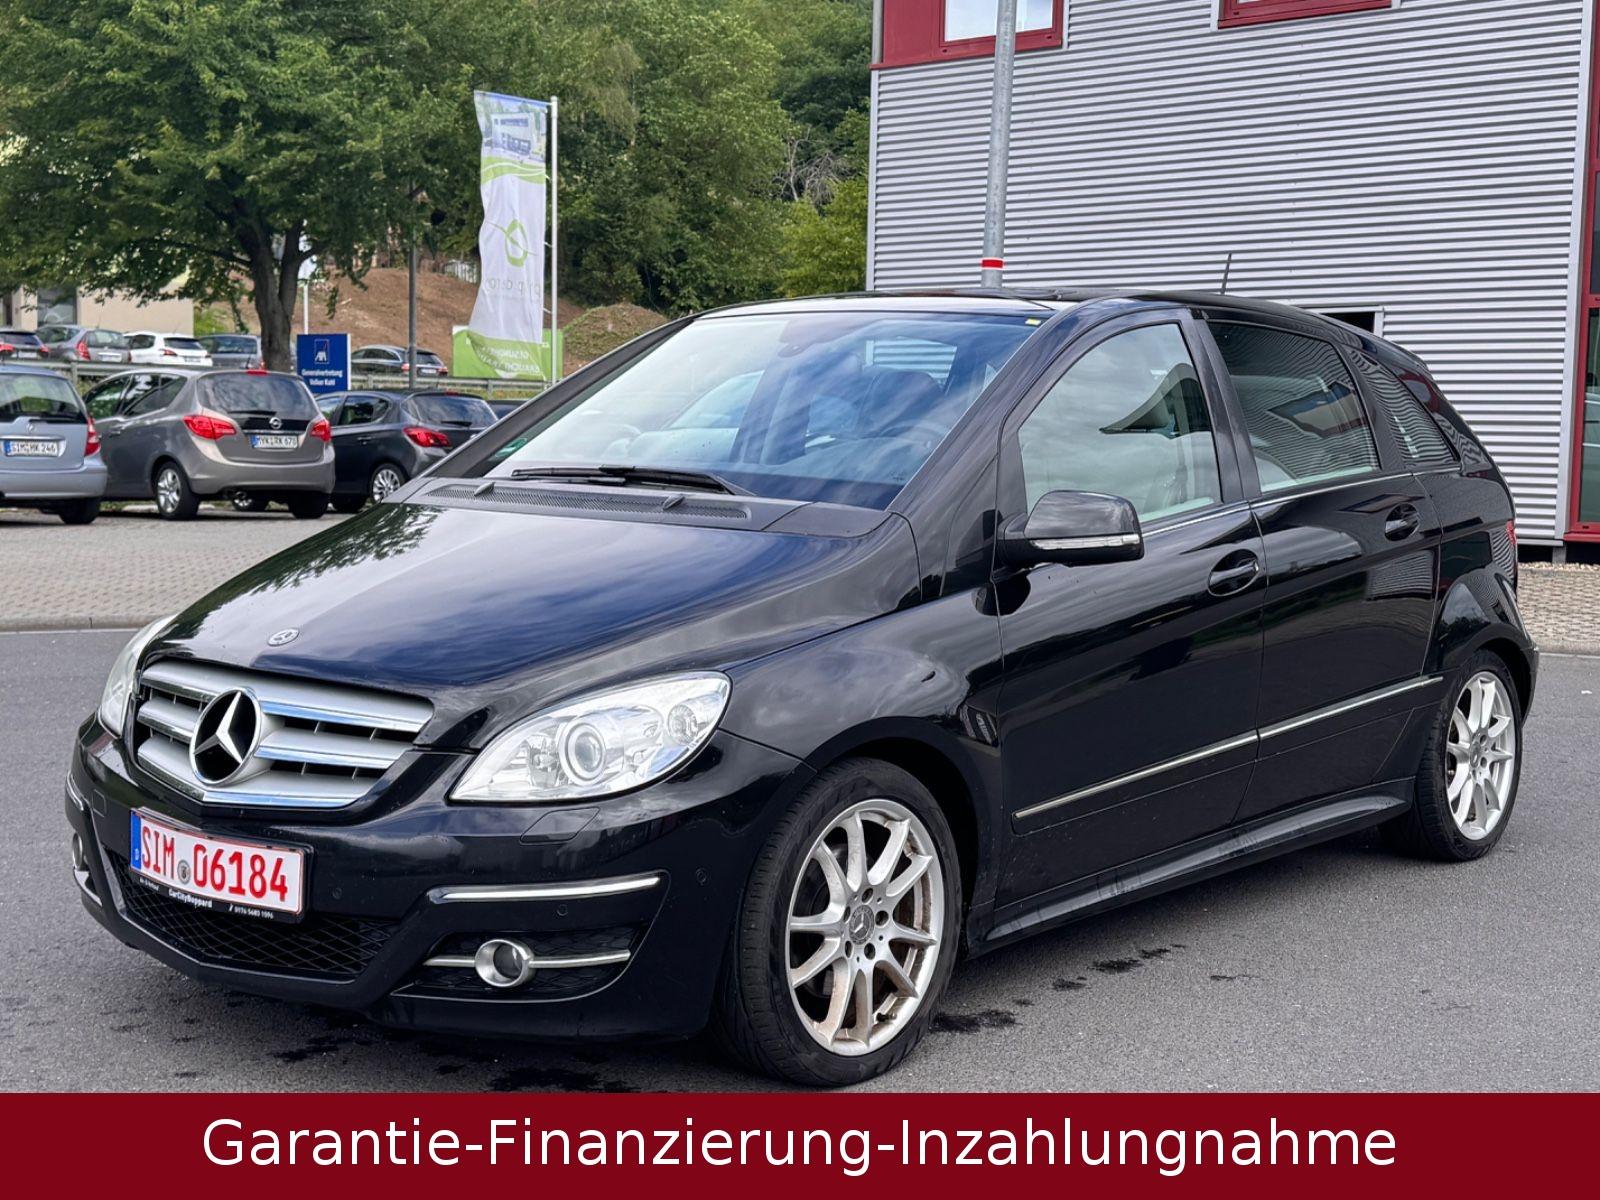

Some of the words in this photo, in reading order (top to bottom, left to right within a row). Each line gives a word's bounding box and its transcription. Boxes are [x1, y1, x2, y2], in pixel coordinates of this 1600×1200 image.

[142, 825, 176, 881] SIM
[193, 843, 288, 902] 06184
[168, 889, 212, 908] CarCityBoppard
